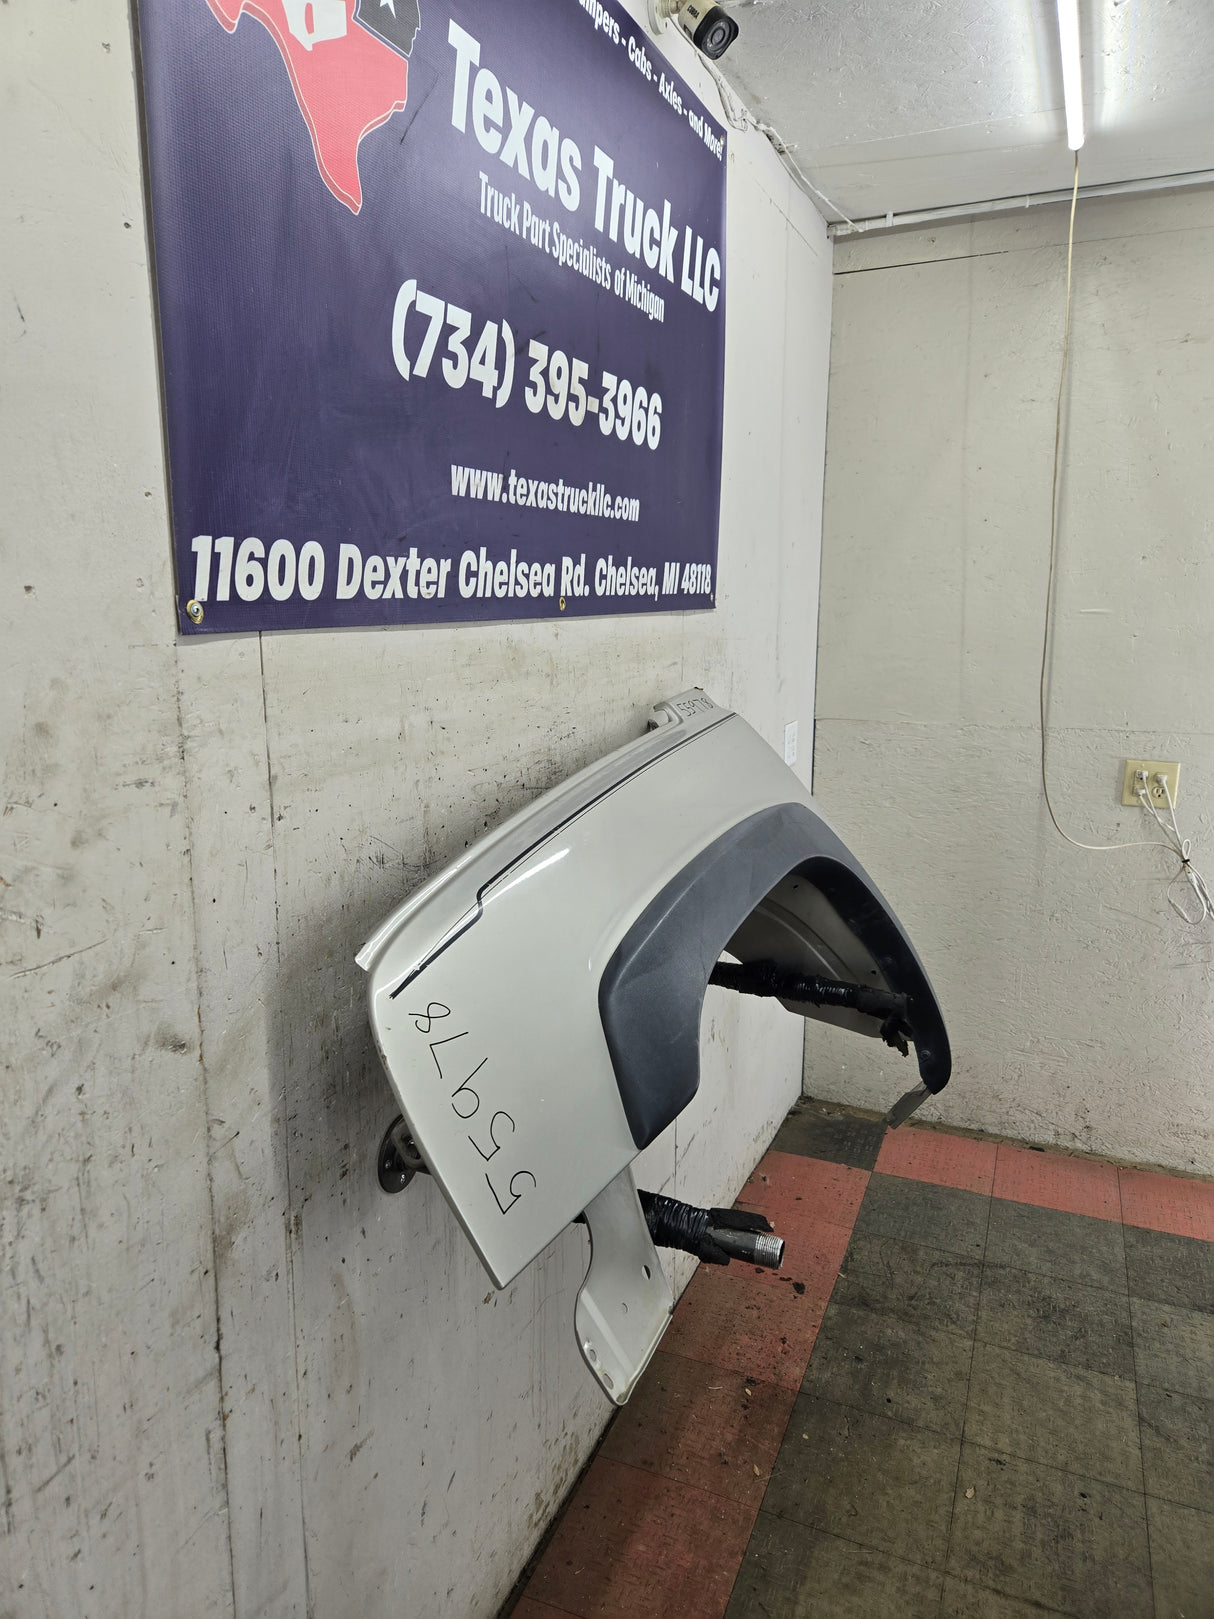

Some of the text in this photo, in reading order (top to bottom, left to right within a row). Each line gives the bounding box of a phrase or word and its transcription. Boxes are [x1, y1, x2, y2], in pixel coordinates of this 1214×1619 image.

[627, 35, 653, 81] Cabs
[658, 72, 683, 116] Axles
[688, 109, 704, 139] and
[447, 18, 721, 312] Texas Truck LLC
[479, 170, 665, 323] Truck Part Specialists of Michigan
[391, 278, 663, 451] (734) 395-3966
[191, 535, 712, 602] 11600 Dexter Chelsea Rd. Chelsea, MI 48118
[450, 464, 640, 522] www.texastruckllc.com
[408, 1002, 537, 1215] 55978
